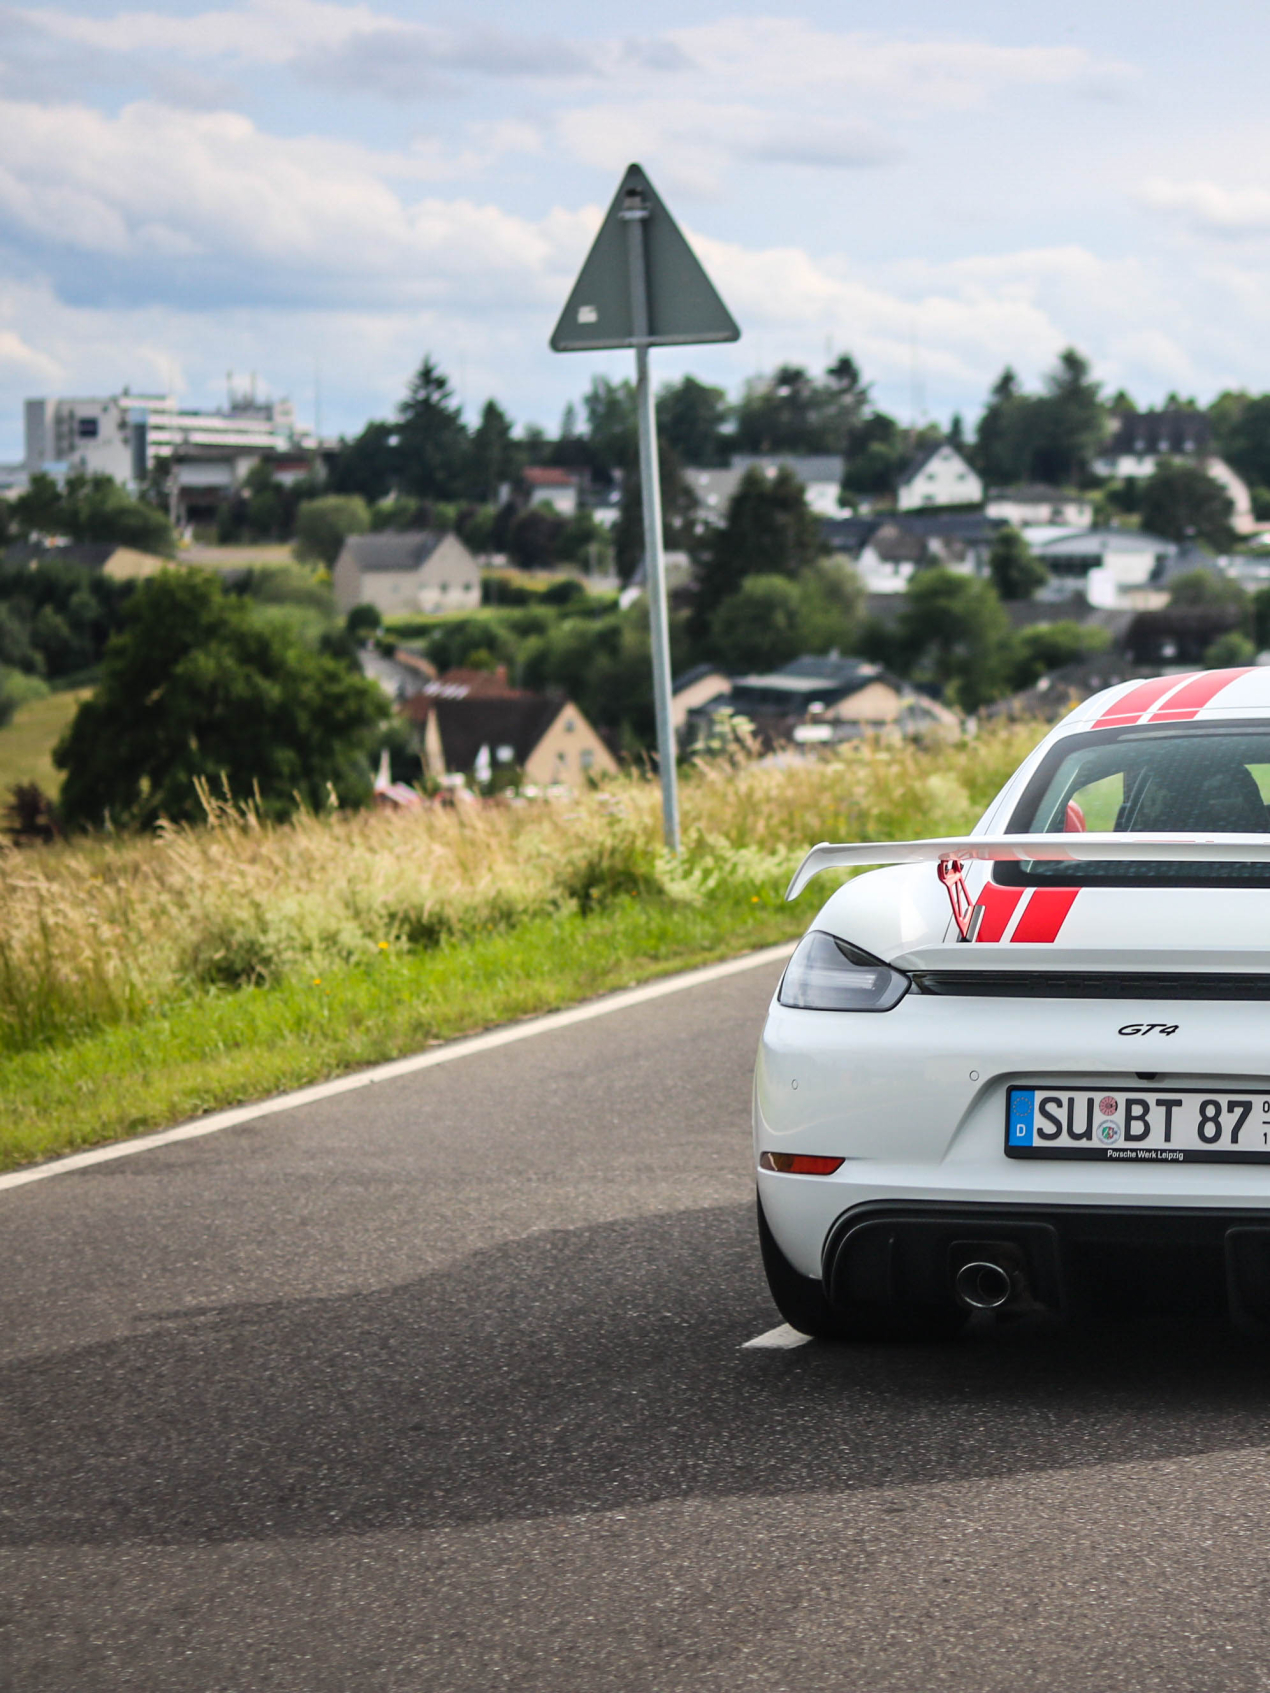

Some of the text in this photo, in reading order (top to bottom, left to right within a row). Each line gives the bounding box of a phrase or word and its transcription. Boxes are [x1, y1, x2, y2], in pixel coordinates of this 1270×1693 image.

[1118, 1023, 1179, 1036] GT4
[1036, 1096, 1095, 1141] SU
[1123, 1098, 1183, 1142] BT
[1197, 1099, 1253, 1144] 87
[1016, 1124, 1026, 1137] D
[1107, 1150, 1184, 1161] Porsche Werk Leipzig
